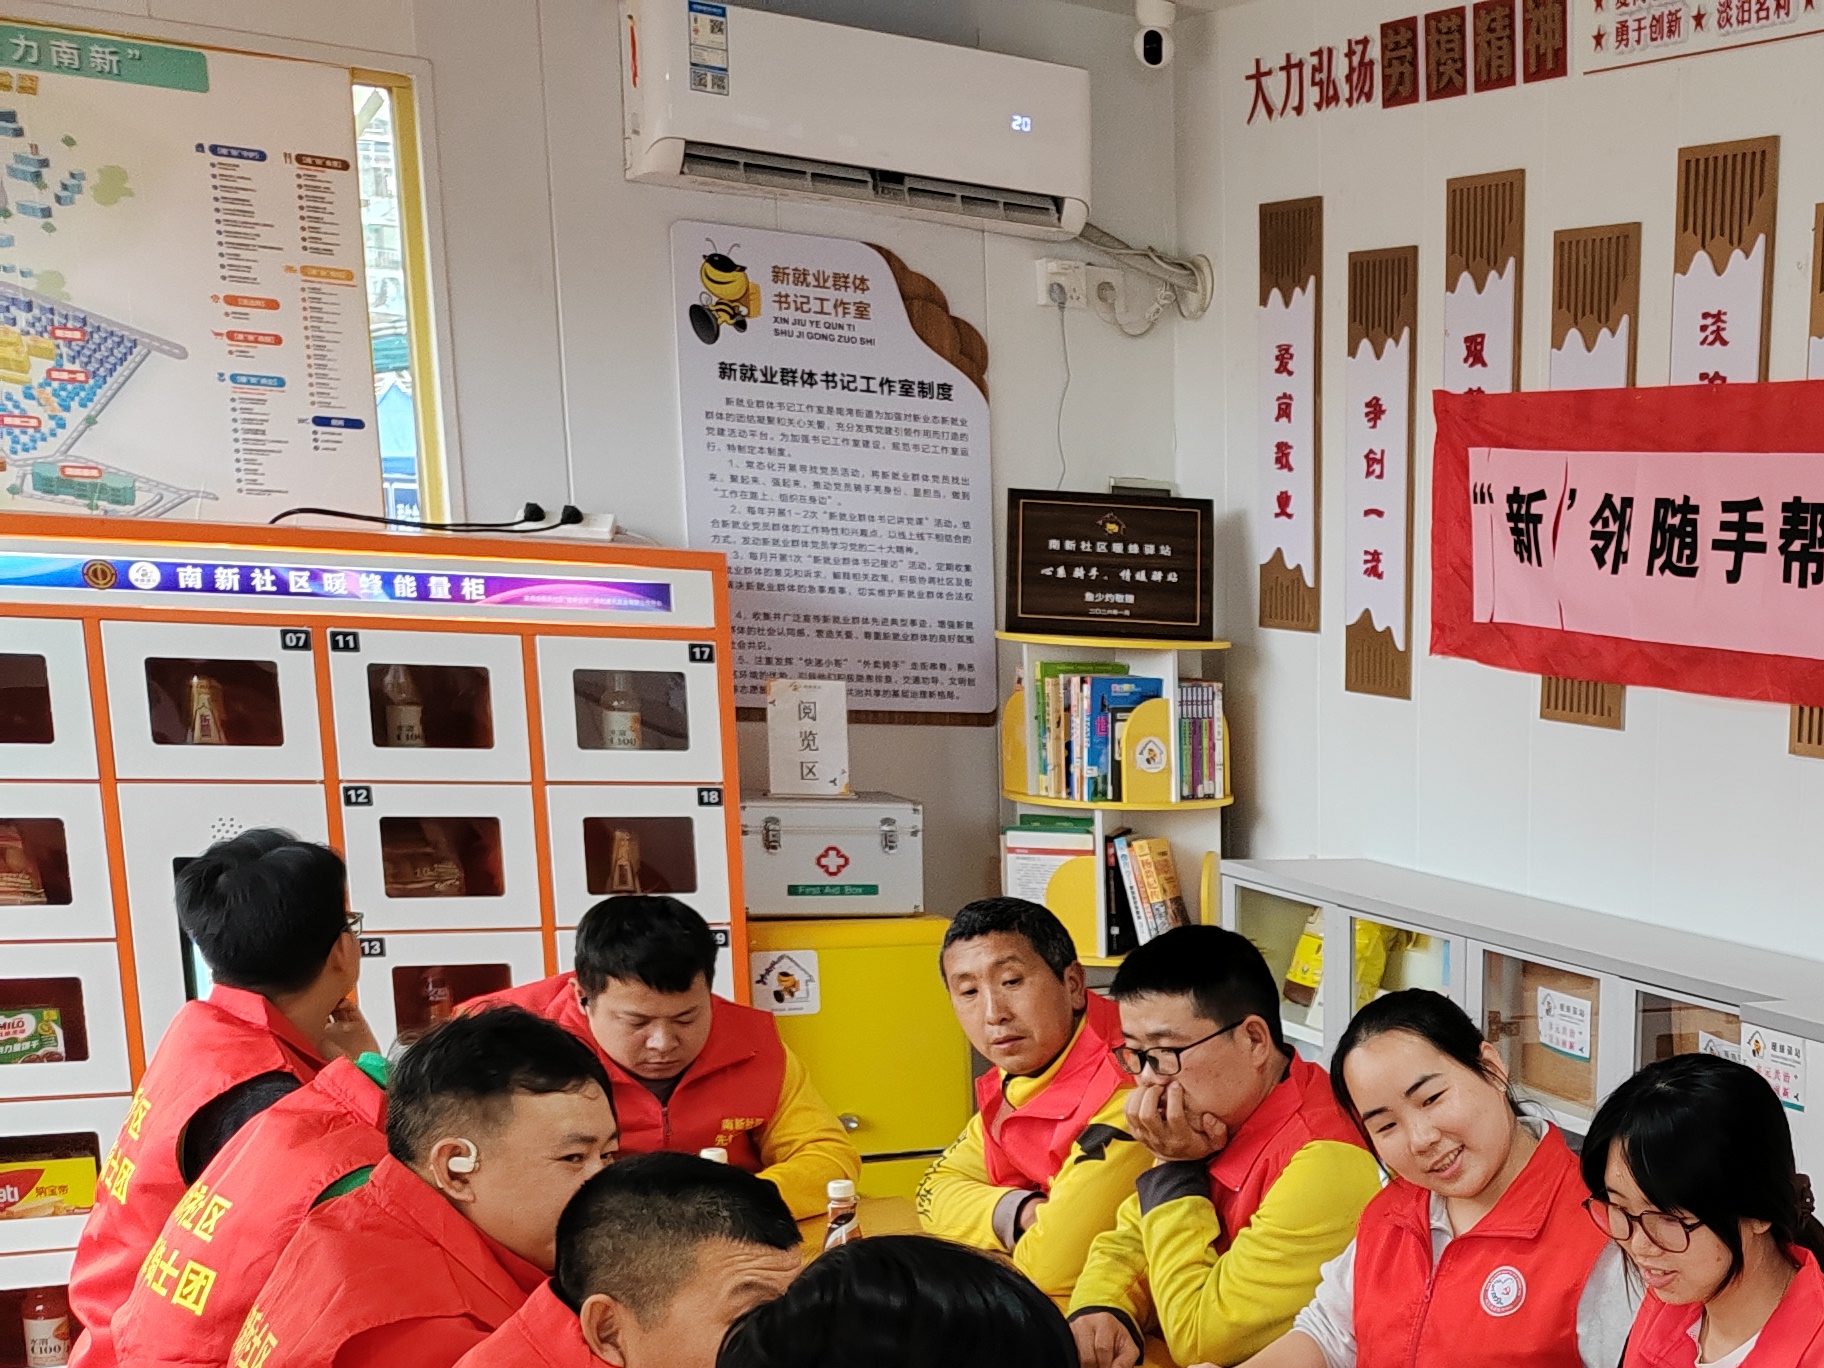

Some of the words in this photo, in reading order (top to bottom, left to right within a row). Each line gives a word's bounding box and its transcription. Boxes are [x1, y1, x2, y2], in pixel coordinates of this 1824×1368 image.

[1615, 10, 1682, 50] 勇于创新
[1011, 115, 1031, 132] 20
[771, 264, 870, 295] 新就业群体
[773, 292, 872, 321] 书记工作室
[773, 316, 789, 326] XIN
[791, 317, 806, 327] JIU
[809, 318, 821, 328] YE
[823, 320, 844, 331] QUN
[847, 323, 855, 332] TI
[773, 328, 794, 339] SHU
[837, 333, 857, 345] ZUO
[860, 335, 875, 347] SHI
[718, 360, 954, 401] 新就业群体书记工作室制度
[1363, 396, 1386, 581] 争创一流
[1048, 538, 1172, 557] 南新社区暖蜂驿站
[176, 565, 487, 601] 南新社区暖蜂能量柜
[285, 633, 307, 648] 07
[335, 635, 356, 649] 11
[692, 647, 712, 661] 17
[798, 700, 819, 781] 阅览区
[347, 789, 368, 803] 12
[701, 790, 719, 804] 18
[798, 885, 821, 895] First
[844, 886, 863, 895] Box
[361, 940, 381, 955] 13
